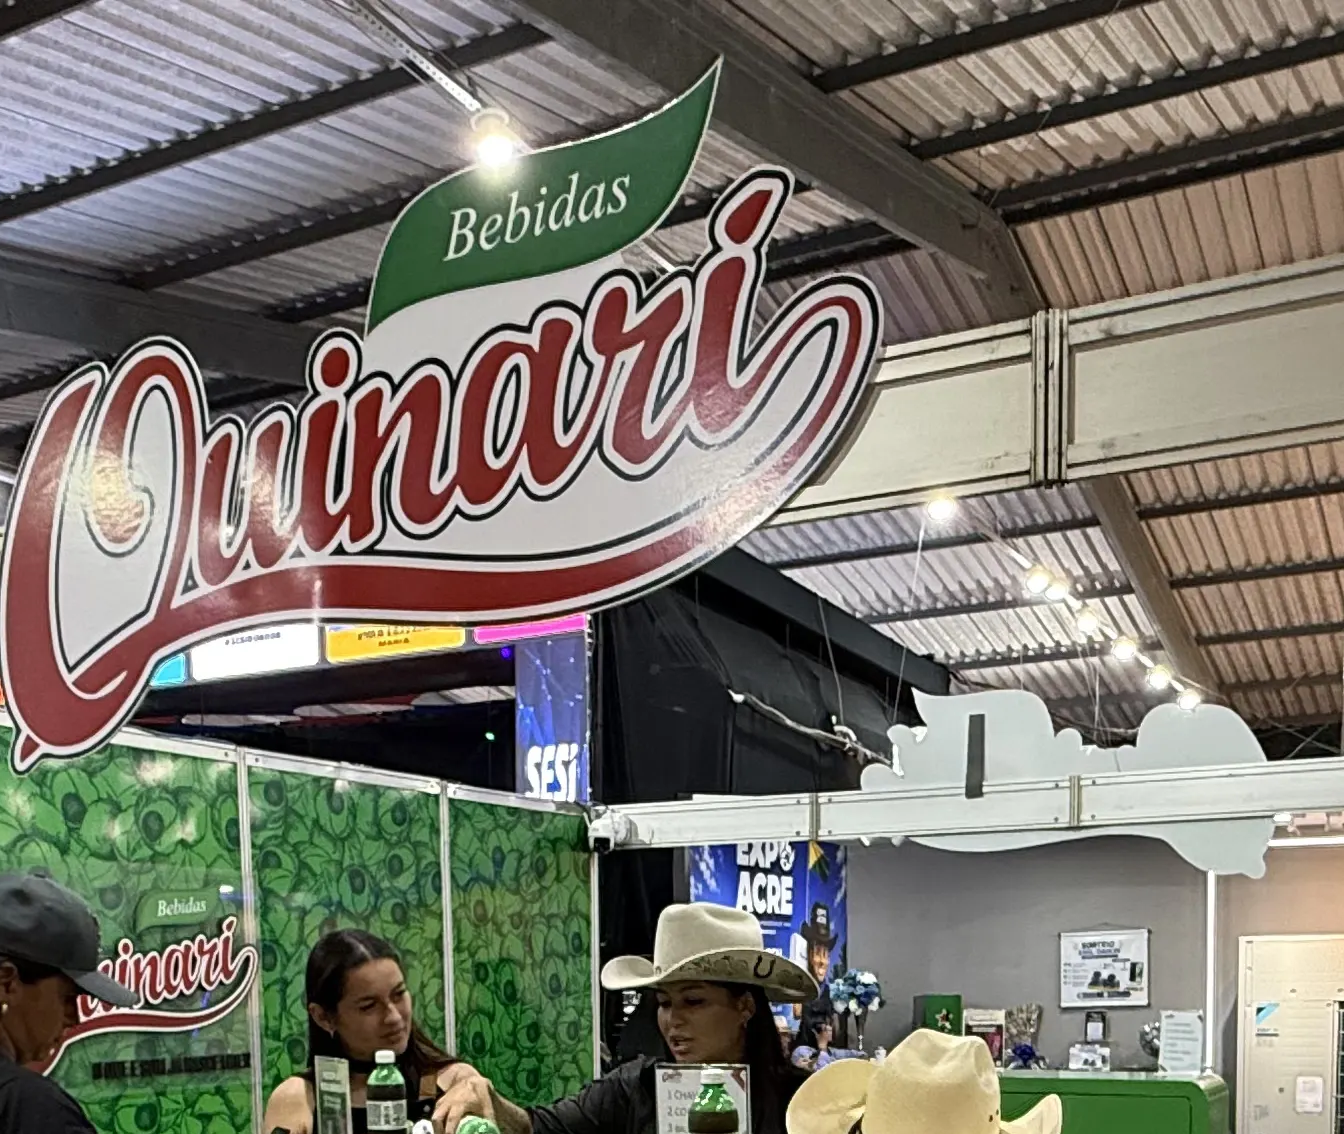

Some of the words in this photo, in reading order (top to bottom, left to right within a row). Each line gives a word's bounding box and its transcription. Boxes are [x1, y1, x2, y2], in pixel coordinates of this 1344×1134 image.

[442, 171, 632, 263] Bebidas
[0, 168, 883, 774] Quinari
[156, 897, 207, 917] Bebidas
[735, 871, 794, 916] ACRE
